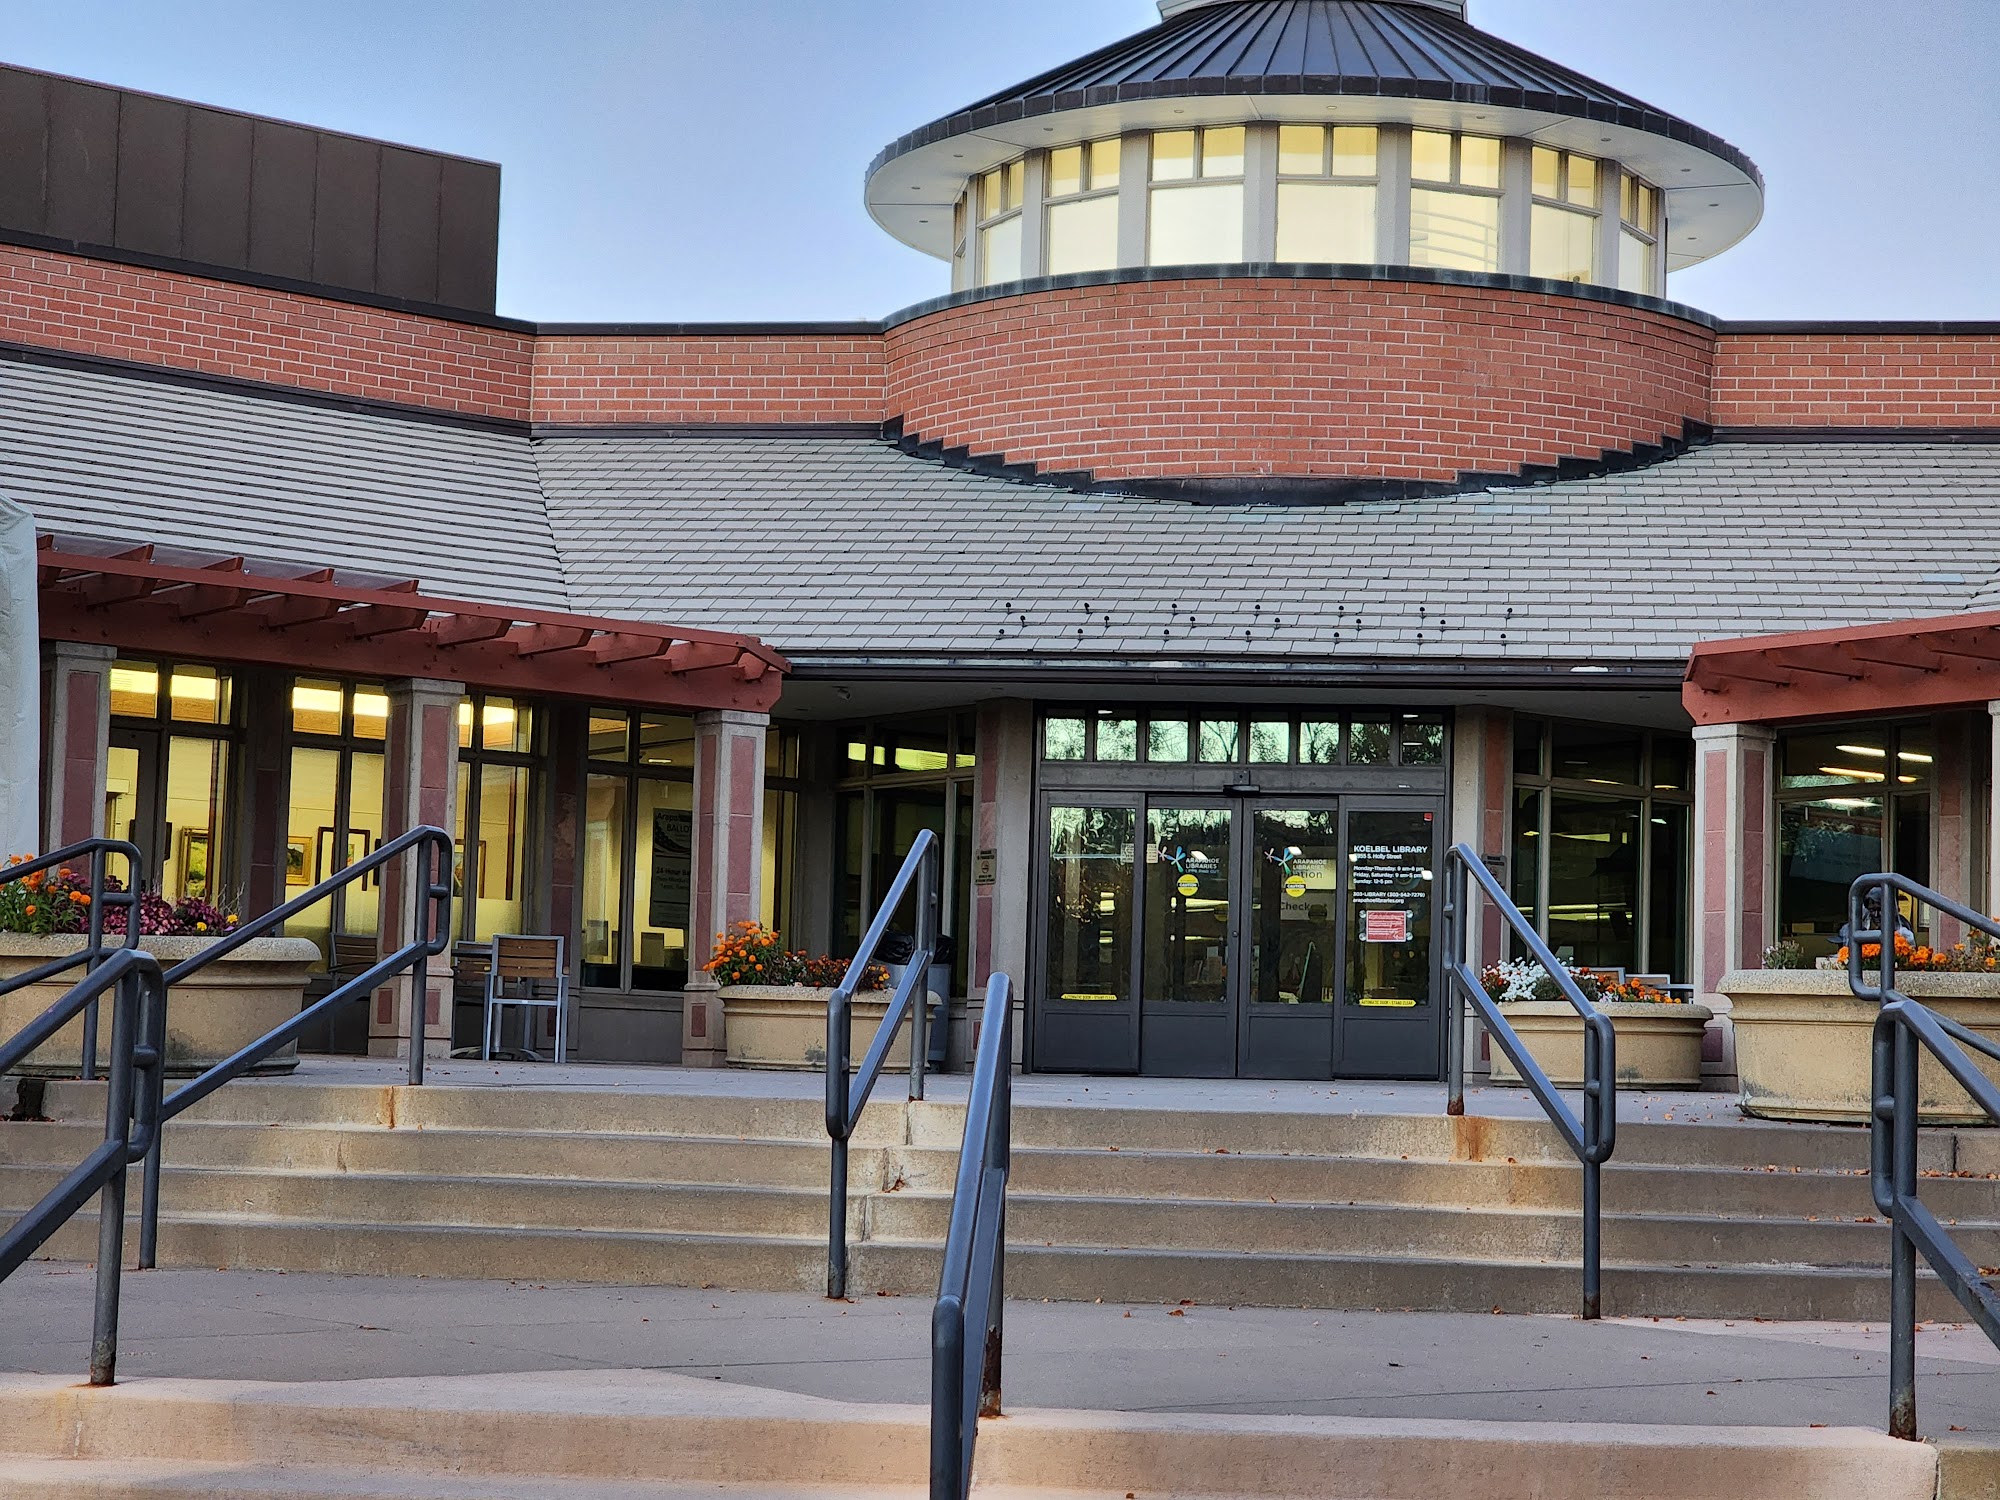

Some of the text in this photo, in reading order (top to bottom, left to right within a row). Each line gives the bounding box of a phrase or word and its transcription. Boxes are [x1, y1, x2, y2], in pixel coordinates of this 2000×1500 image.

[666, 823, 691, 833] BALLO
[1353, 845, 1428, 853] KOELBEL LIBRARY
